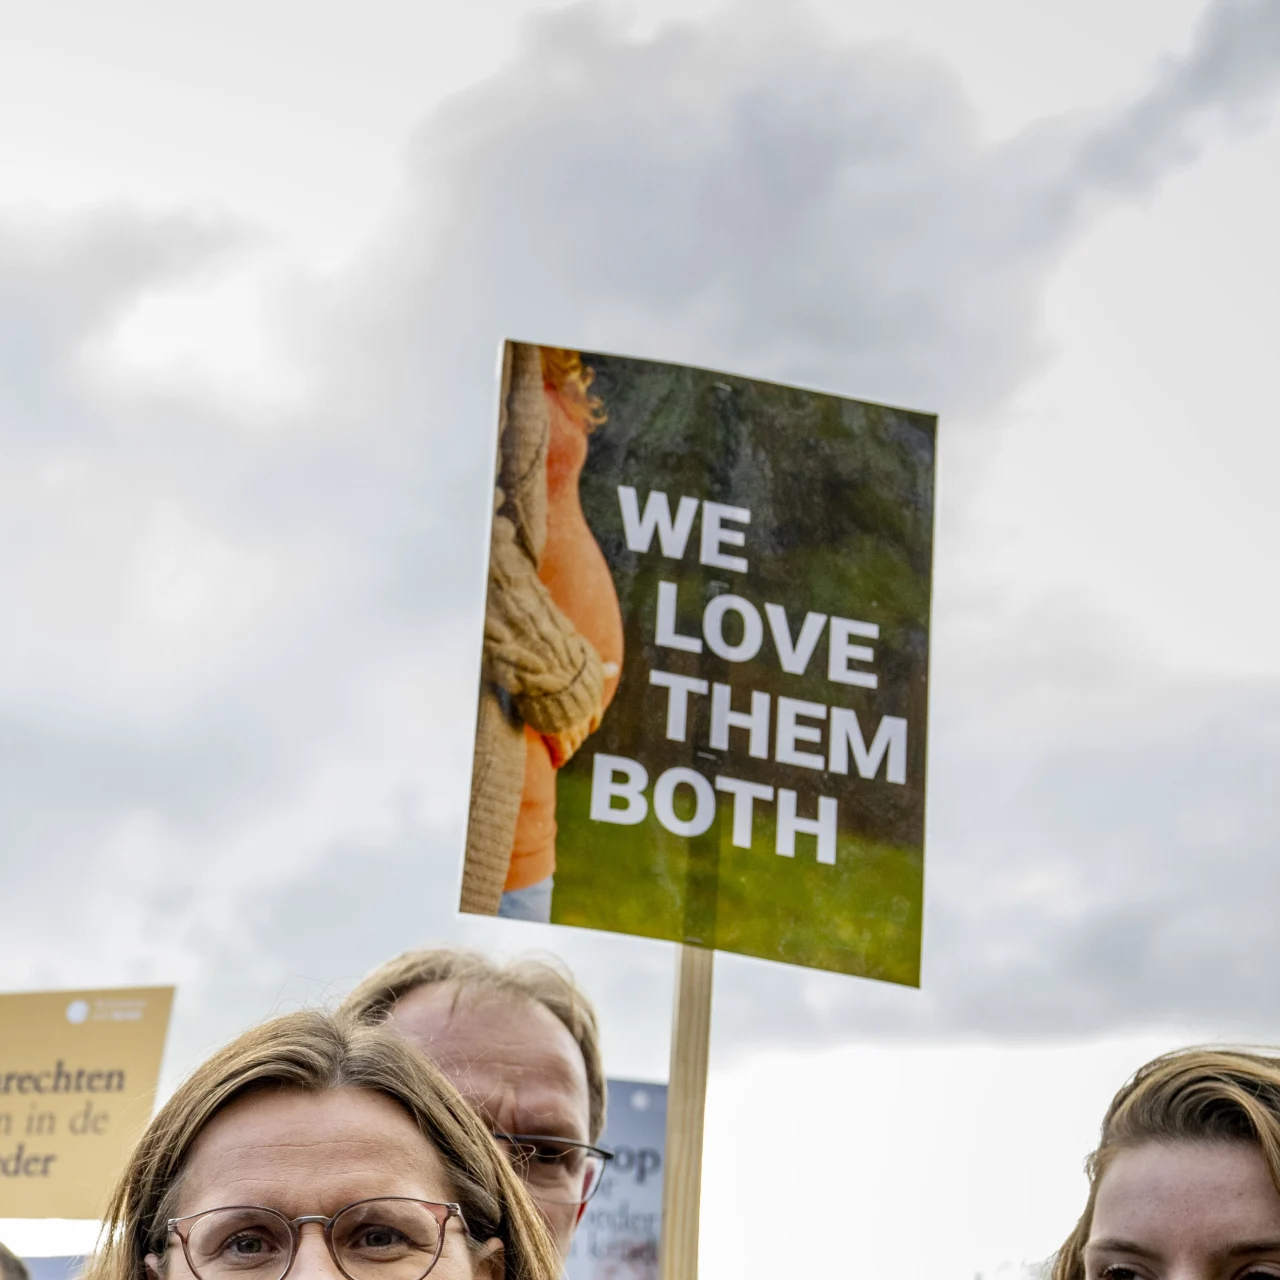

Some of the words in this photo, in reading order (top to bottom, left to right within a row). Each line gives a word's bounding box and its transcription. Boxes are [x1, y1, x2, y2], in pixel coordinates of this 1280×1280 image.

[617, 485, 751, 574] WE
[654, 580, 880, 690] LOVE
[648, 669, 909, 786] THEM
[589, 752, 838, 866] BOTH
[25, 1103, 56, 1137] in
[69, 1102, 110, 1137] de
